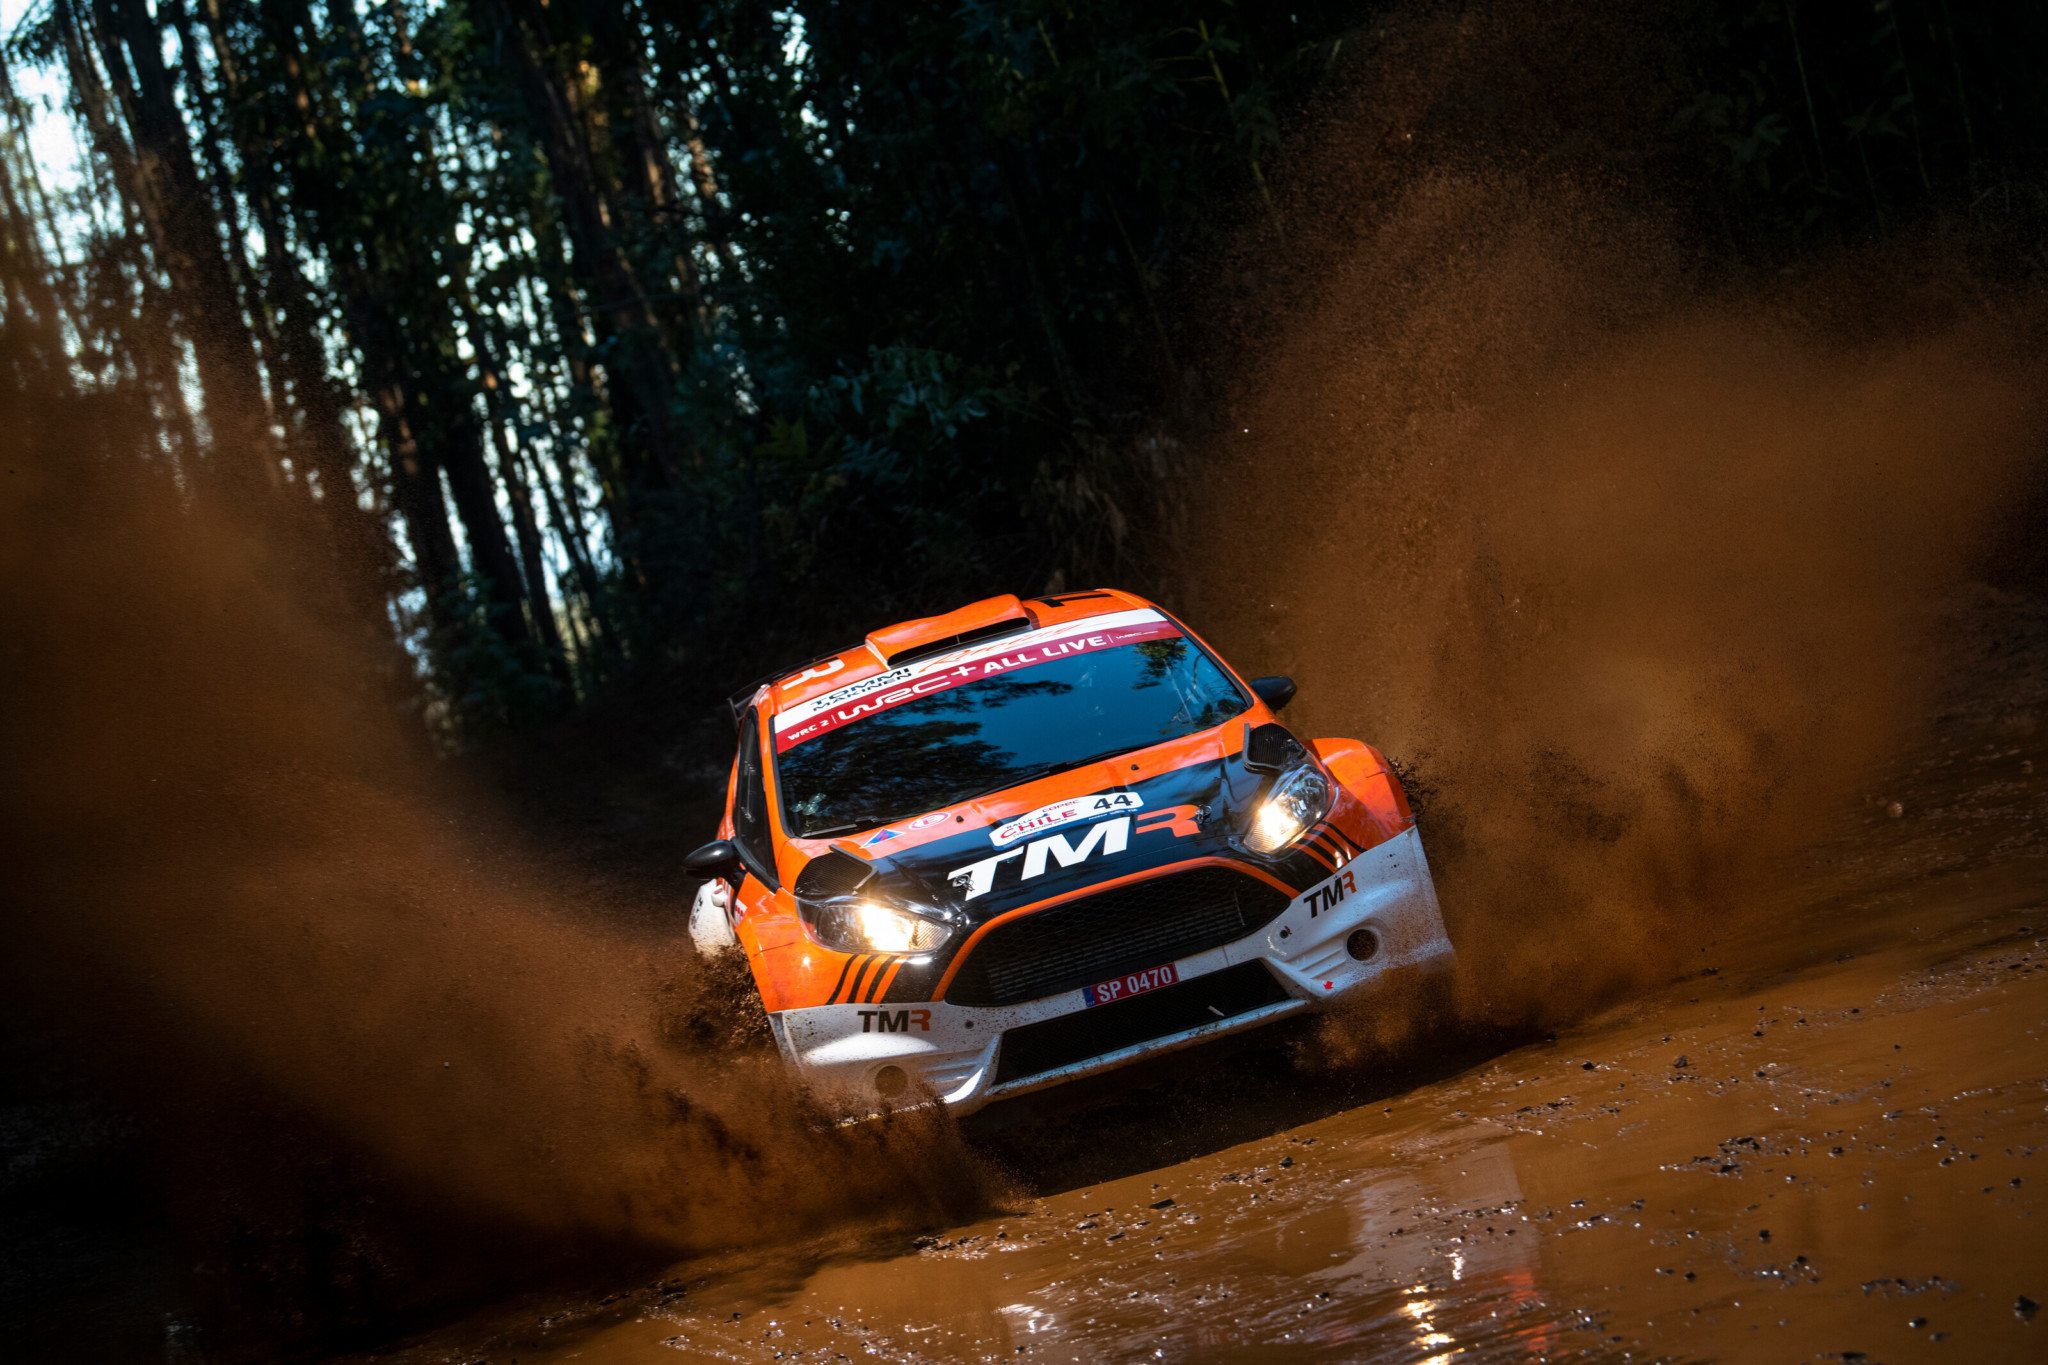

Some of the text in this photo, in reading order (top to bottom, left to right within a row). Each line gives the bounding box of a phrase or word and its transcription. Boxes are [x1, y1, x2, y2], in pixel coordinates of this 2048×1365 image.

[787, 724, 818, 740] WRC
[821, 719, 830, 727] 2
[983, 654, 1037, 675] ALL
[1042, 635, 1107, 657] LIVE
[810, 668, 909, 706] TOMMI
[812, 672, 913, 712] MAKINEN
[1094, 795, 1133, 809] 44
[1000, 809, 1077, 838] CHILE
[1006, 819, 1033, 829] RALLY
[947, 804, 1202, 901] TMR
[1303, 870, 1357, 918] TMR
[1097, 980, 1121, 1002] SP
[1127, 966, 1172, 993] 0470
[857, 1009, 931, 1033] TMR
